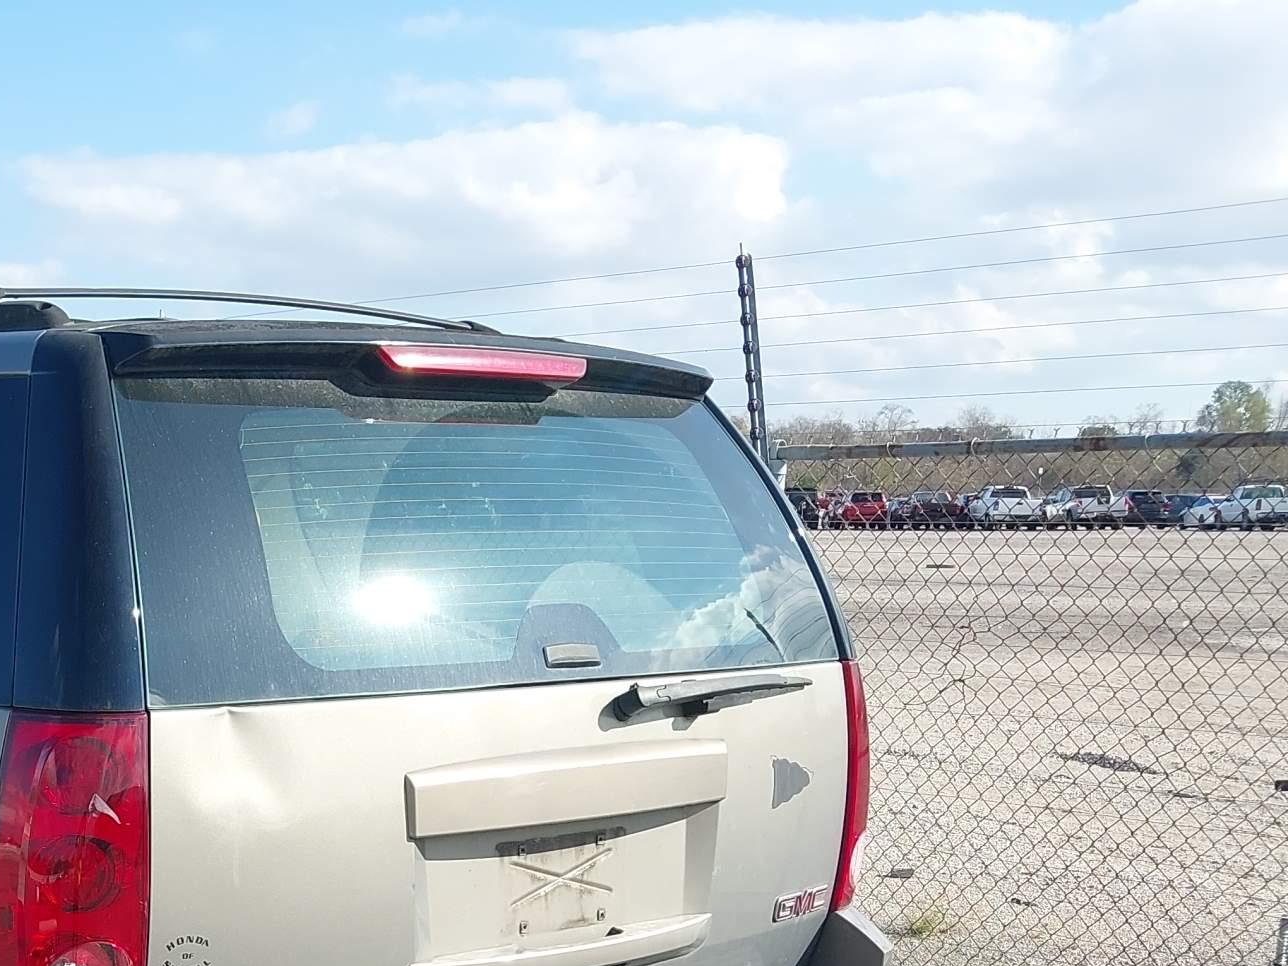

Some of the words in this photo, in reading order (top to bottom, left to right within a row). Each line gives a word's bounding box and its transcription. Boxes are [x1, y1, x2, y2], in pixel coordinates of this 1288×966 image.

[772, 884, 829, 922] GMC
[165, 935, 210, 952] HONDA
[181, 952, 194, 960] OF
